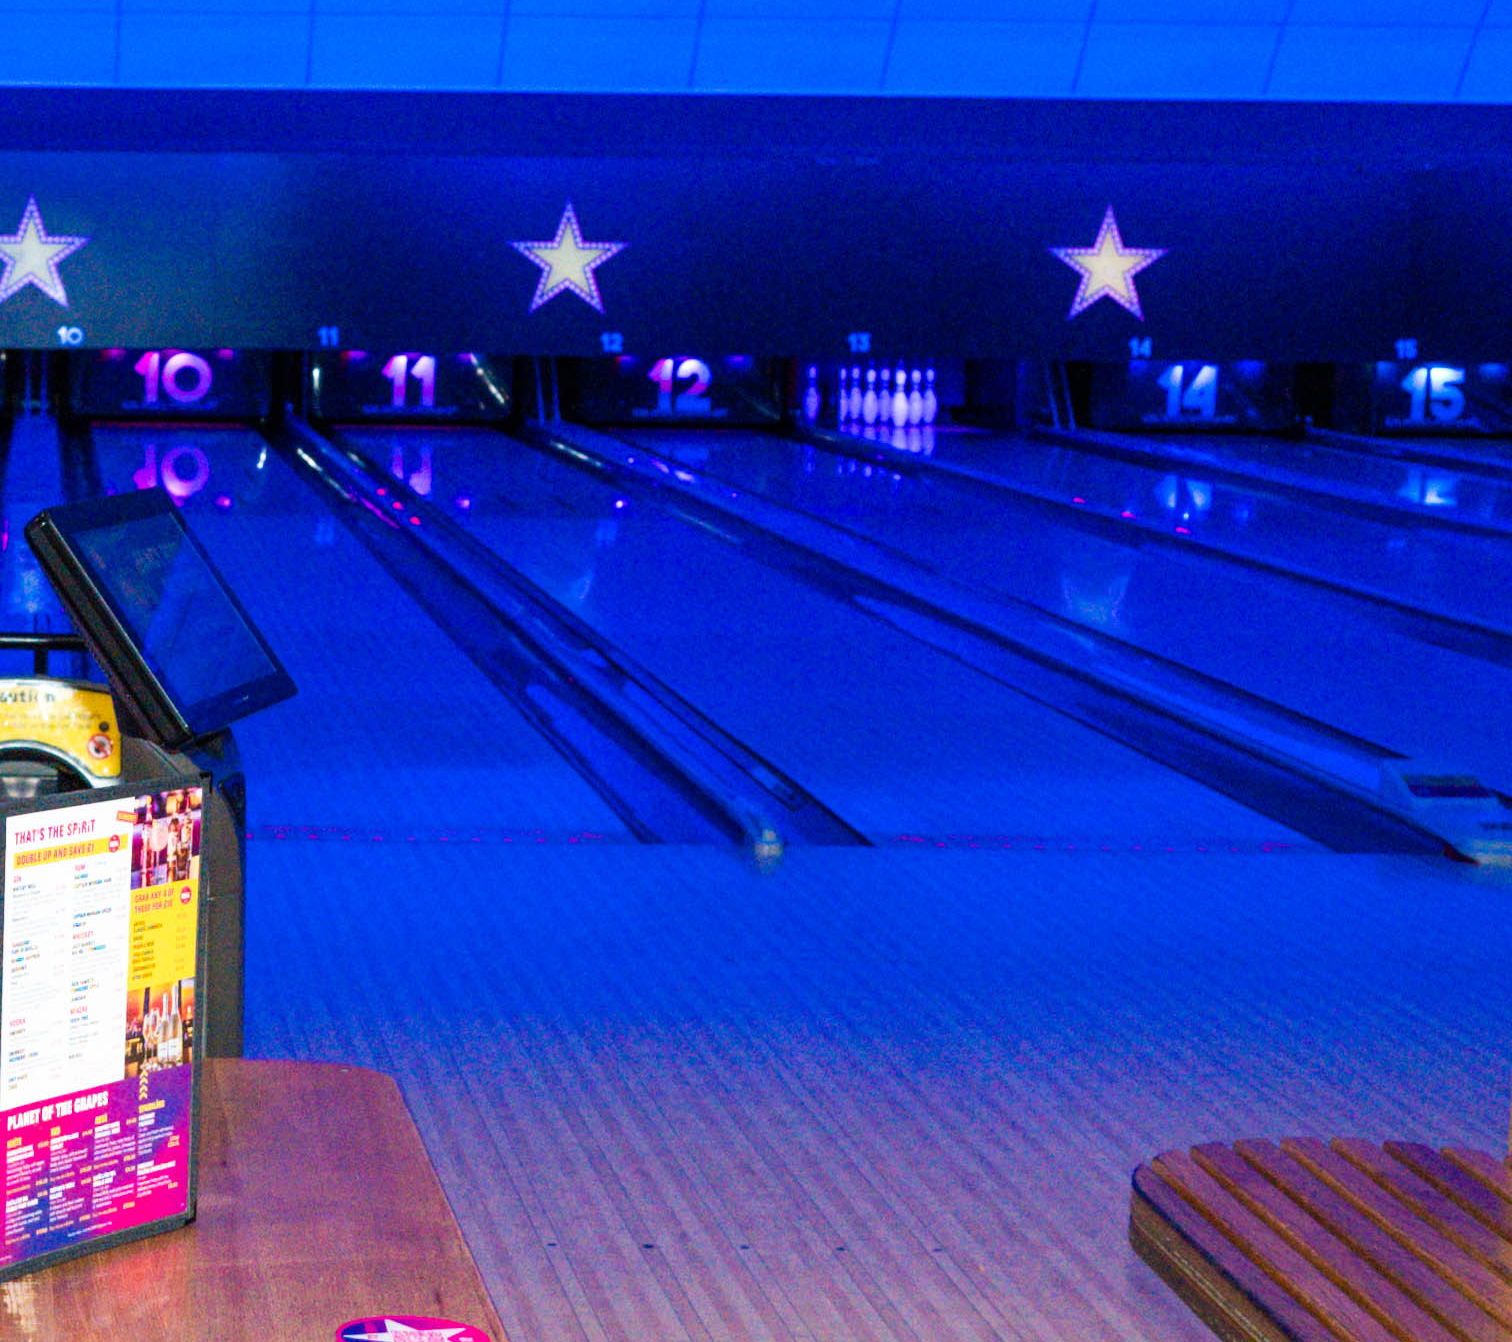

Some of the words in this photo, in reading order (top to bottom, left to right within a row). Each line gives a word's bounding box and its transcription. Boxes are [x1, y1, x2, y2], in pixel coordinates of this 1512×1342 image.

[57, 325, 85, 346] 10
[317, 325, 340, 347] 11
[600, 331, 625, 353] 12
[847, 332, 872, 353] 13
[1128, 336, 1153, 359] 14
[133, 351, 213, 404] 10
[381, 353, 438, 408] 11
[647, 357, 713, 411] 12
[1156, 364, 1220, 419] 14
[1400, 366, 1466, 422] 15
[14, 827, 45, 846] THAT'S
[48, 824, 65, 839] THE
[16, 852, 41, 866] DOUBLE
[42, 850, 52, 862] UP
[53, 847, 68, 859] AND
[69, 845, 86, 857] SAVE
[7, 1108, 41, 1131] PLANET
[41, 1104, 54, 1122] OF
[55, 1100, 73, 1118] THE
[73, 1090, 109, 1113] GRAPES
